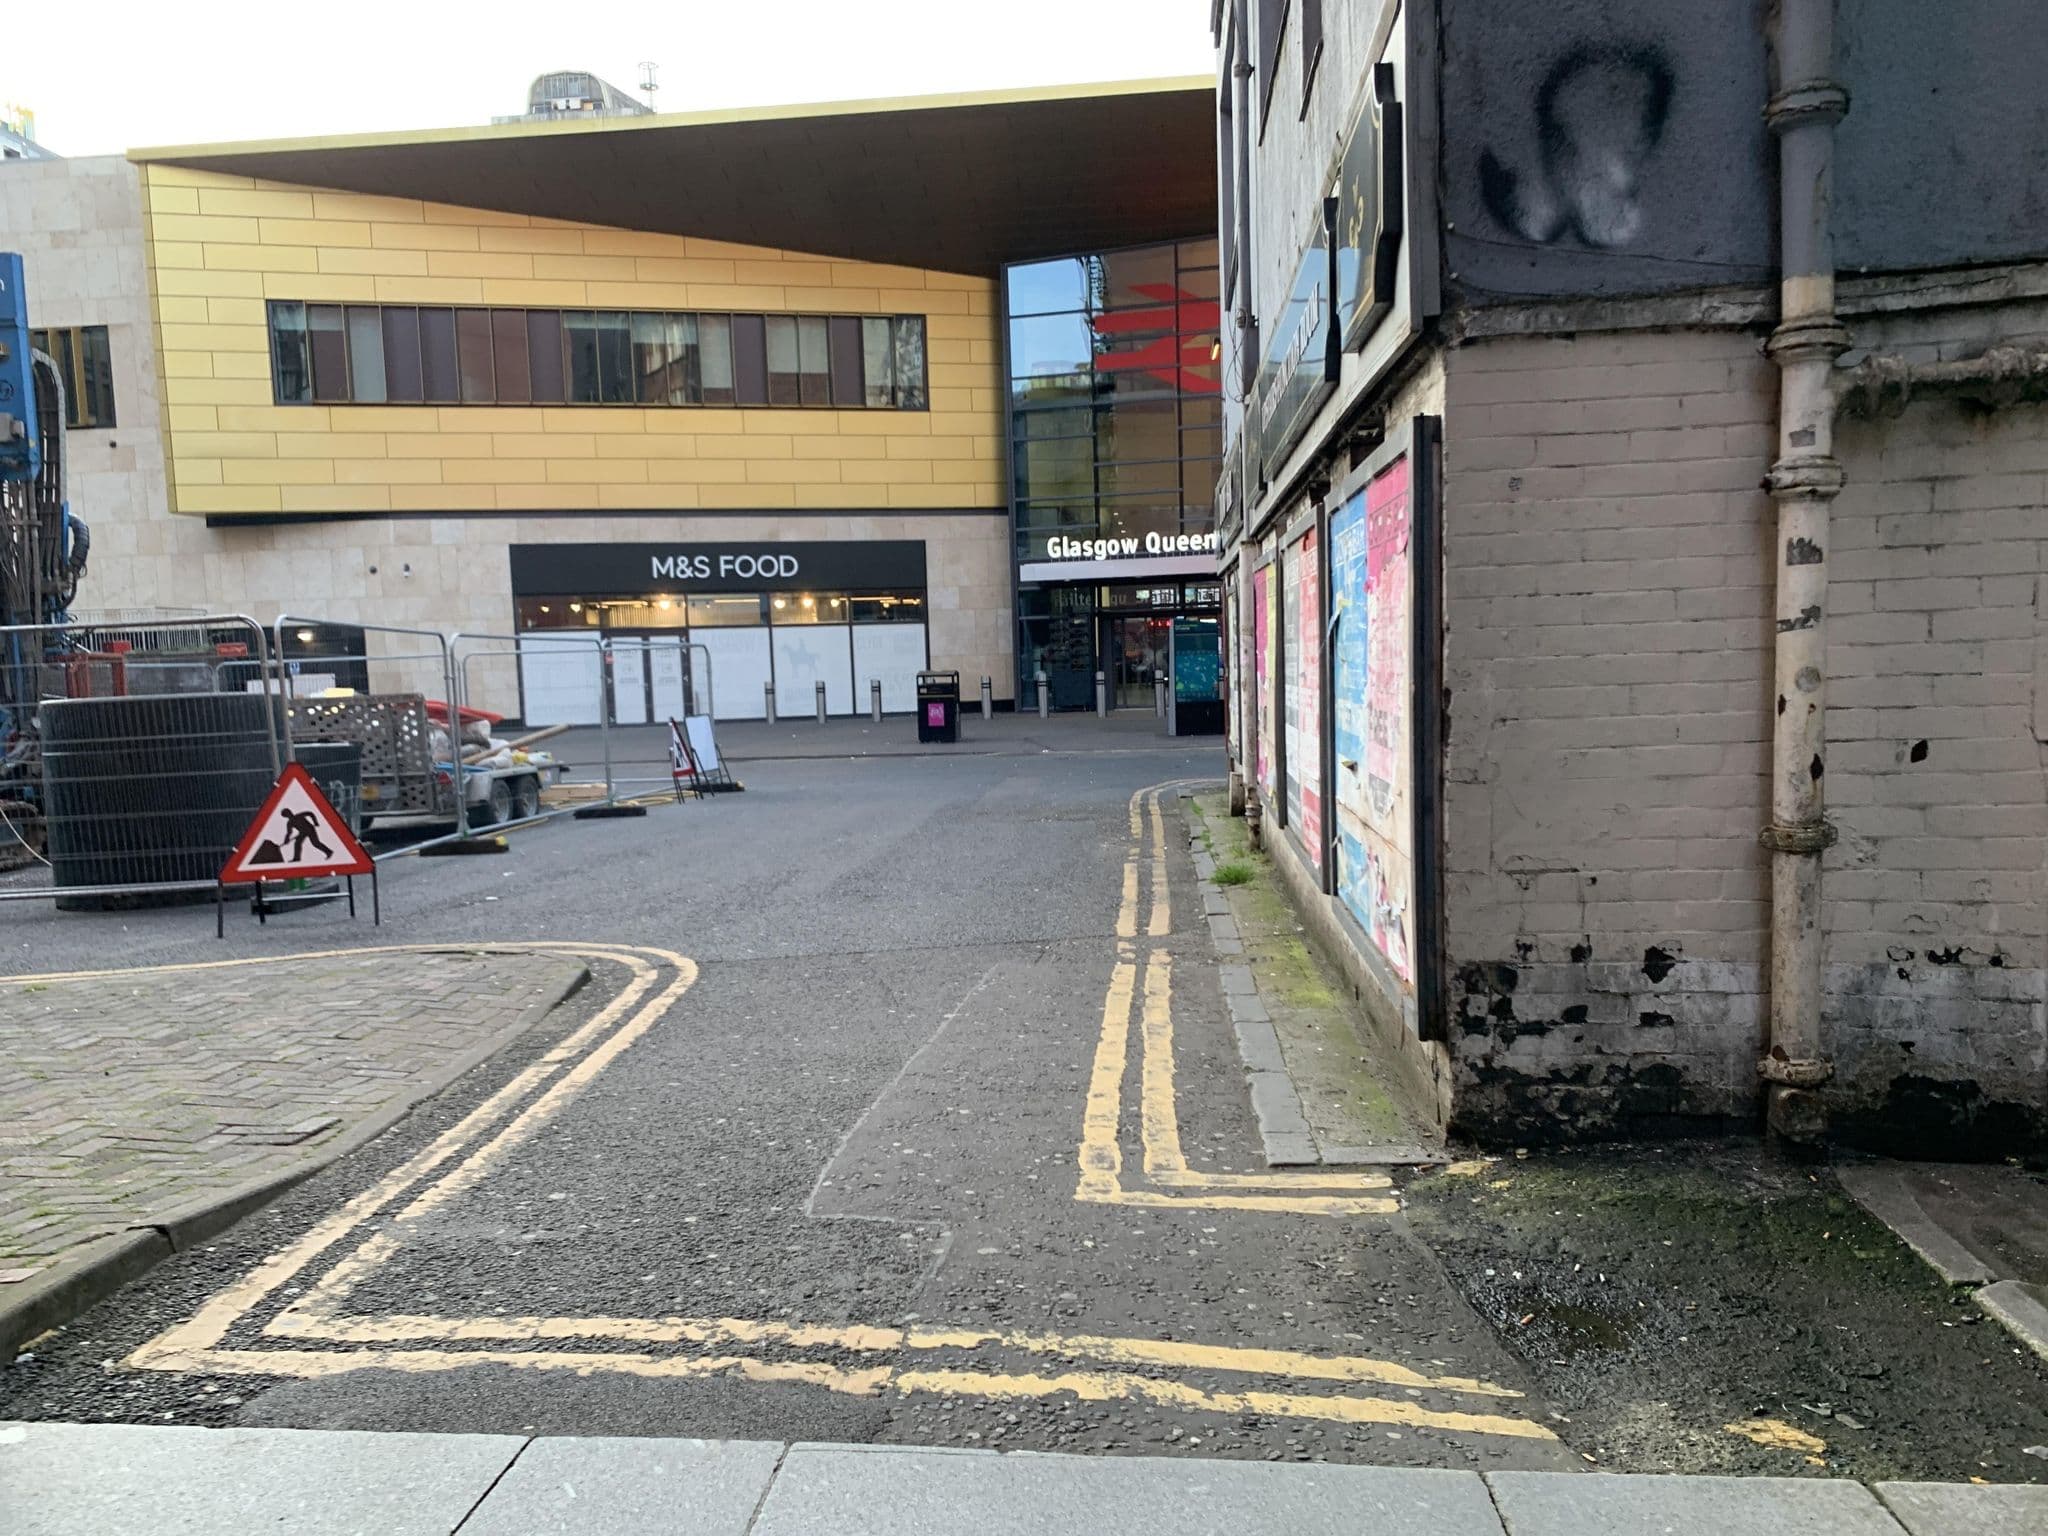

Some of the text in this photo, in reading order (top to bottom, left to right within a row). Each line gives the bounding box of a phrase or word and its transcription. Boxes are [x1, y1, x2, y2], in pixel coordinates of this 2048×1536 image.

[1047, 531, 1218, 561] Glasgow Queen
[651, 554, 799, 579] M&S FOOD
